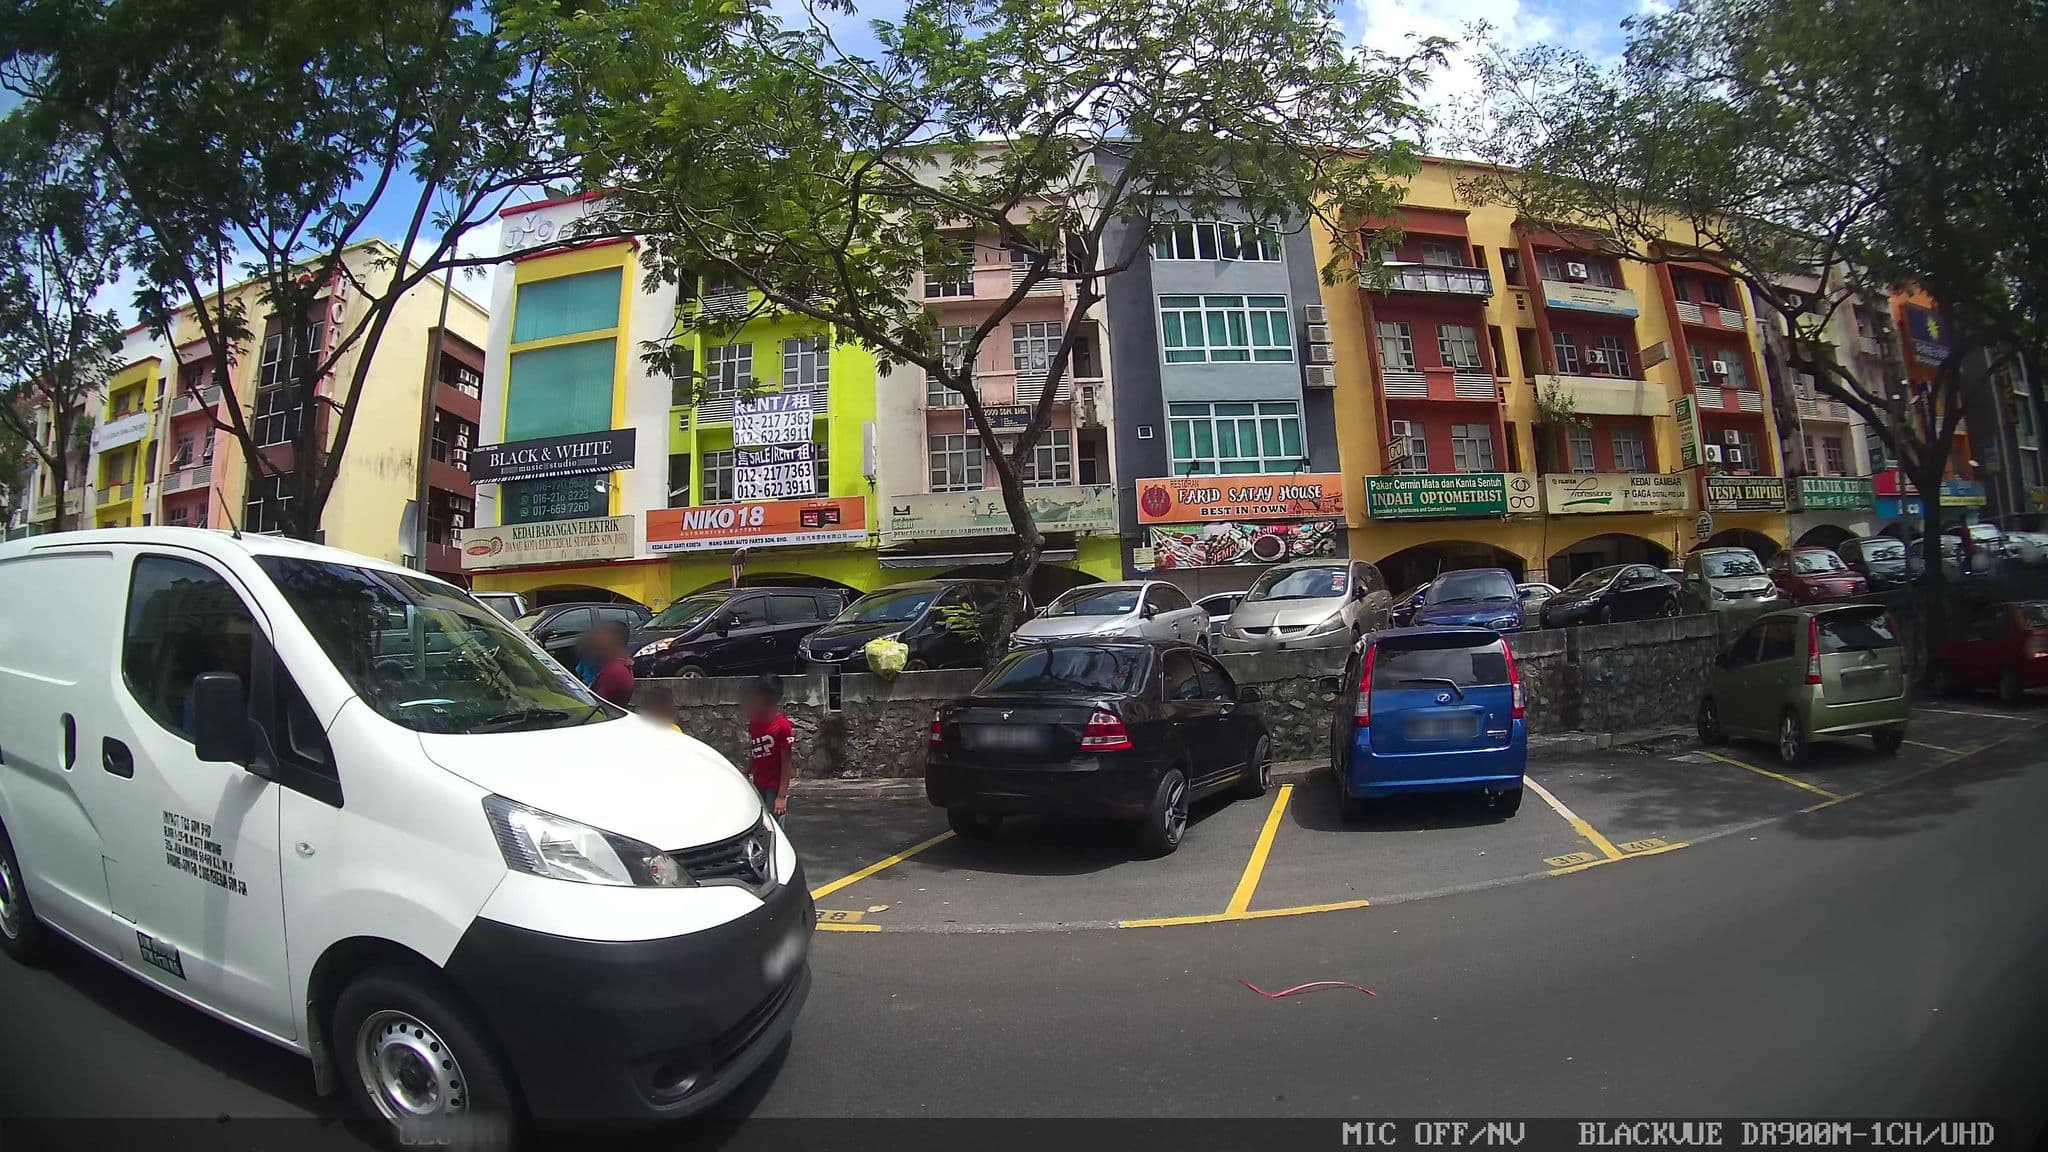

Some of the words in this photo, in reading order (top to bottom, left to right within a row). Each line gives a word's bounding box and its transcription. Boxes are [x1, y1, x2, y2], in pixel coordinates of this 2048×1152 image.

[785, 411, 810, 426] 7363
[783, 427, 810, 442] 3911
[490, 448, 539, 467] BLACK
[541, 447, 552, 462] &
[556, 440, 612, 460] WHITE
[518, 462, 543, 473] music
[550, 459, 577, 470] studio
[785, 463, 811, 479] 7363
[1169, 479, 1199, 489] RESTORAN
[1370, 480, 1392, 491] Pakar
[1394, 479, 1421, 490] Cermin
[1422, 479, 1440, 489] Mata
[1441, 478, 1455, 488] dan
[1455, 478, 1477, 488] Kanta
[1478, 477, 1502, 488] Sentuh
[1630, 477, 1650, 487] KEDAI
[1654, 476, 1682, 486] GAMBAR
[1802, 479, 1843, 493] KLINIK
[568, 489, 589, 502] 8223
[737, 482, 784, 499] 012-622
[786, 480, 812, 495] 3911
[1178, 488, 1220, 505] FARID
[1228, 486, 1273, 503] SATAY
[1278, 484, 1322, 501] HOUSE
[1632, 489, 1651, 498] GAGA
[1708, 486, 1743, 500] VESPA
[1744, 485, 1784, 499] EMPIRE
[1372, 492, 1412, 506] INDAH
[1419, 489, 1503, 505] OPTOMETRIST
[532, 503, 566, 517] 017-669
[568, 501, 589, 515] 7260
[1200, 507, 1231, 516] BEST
[1236, 506, 1249, 515] IN
[1252, 504, 1287, 514] TOWN
[682, 509, 735, 531] NIKO
[737, 505, 765, 527] 18
[512, 525, 535, 540] KEDAI
[536, 522, 577, 538] BARANGAN
[578, 518, 620, 534] ELEKTRIK
[680, 528, 729, 537] AUTOMOTIVE
[730, 525, 762, 534] BATTERY
[535, 538, 571, 550] ELECTRICAL
